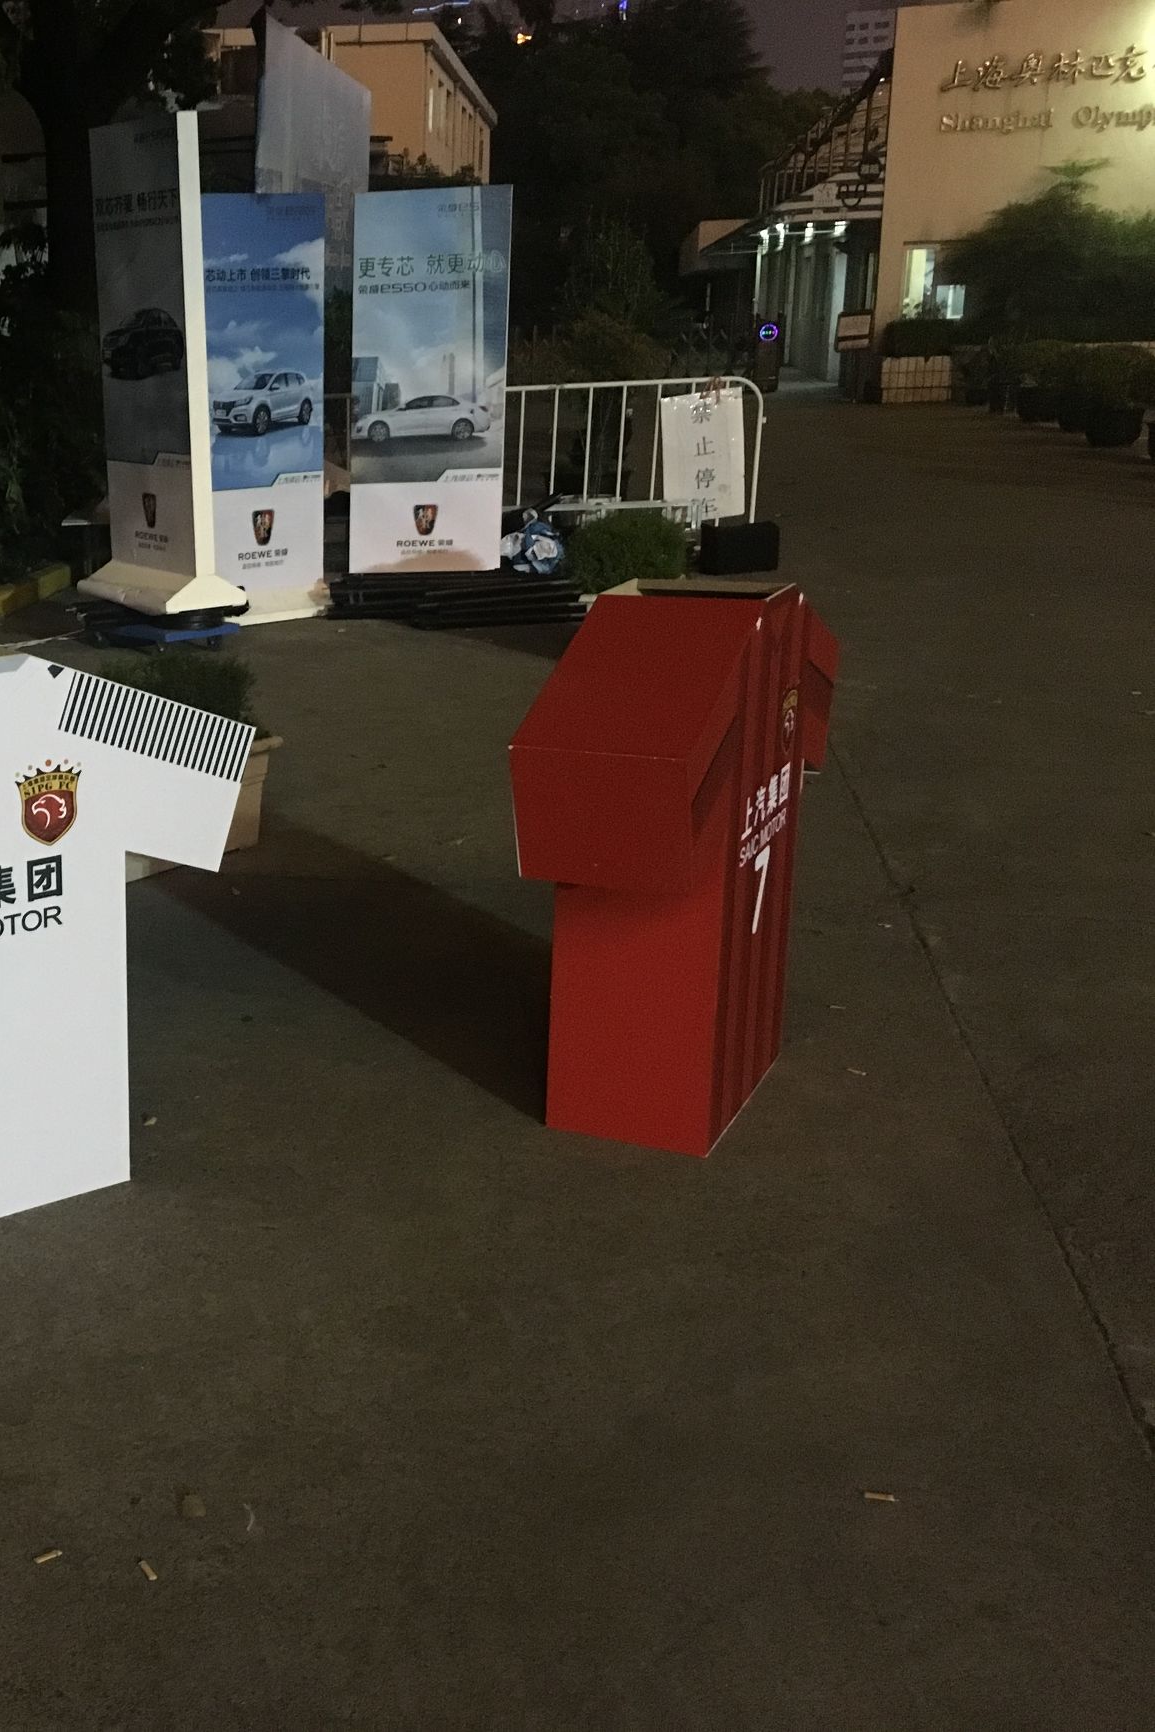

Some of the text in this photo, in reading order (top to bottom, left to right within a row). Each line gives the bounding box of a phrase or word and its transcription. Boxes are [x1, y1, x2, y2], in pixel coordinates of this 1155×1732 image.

[940, 43, 1155, 92] 上海奥林匹克
[941, 108, 1053, 133] Shanghai
[358, 255, 415, 278] 更专芯
[238, 549, 272, 561] ROEWE
[396, 539, 435, 547] ROEWE
[24, 782, 53, 798] SIPG
[59, 781, 71, 789] FC
[741, 762, 791, 841] 上汽集团
[739, 808, 787, 868] SAIC MOTOR
